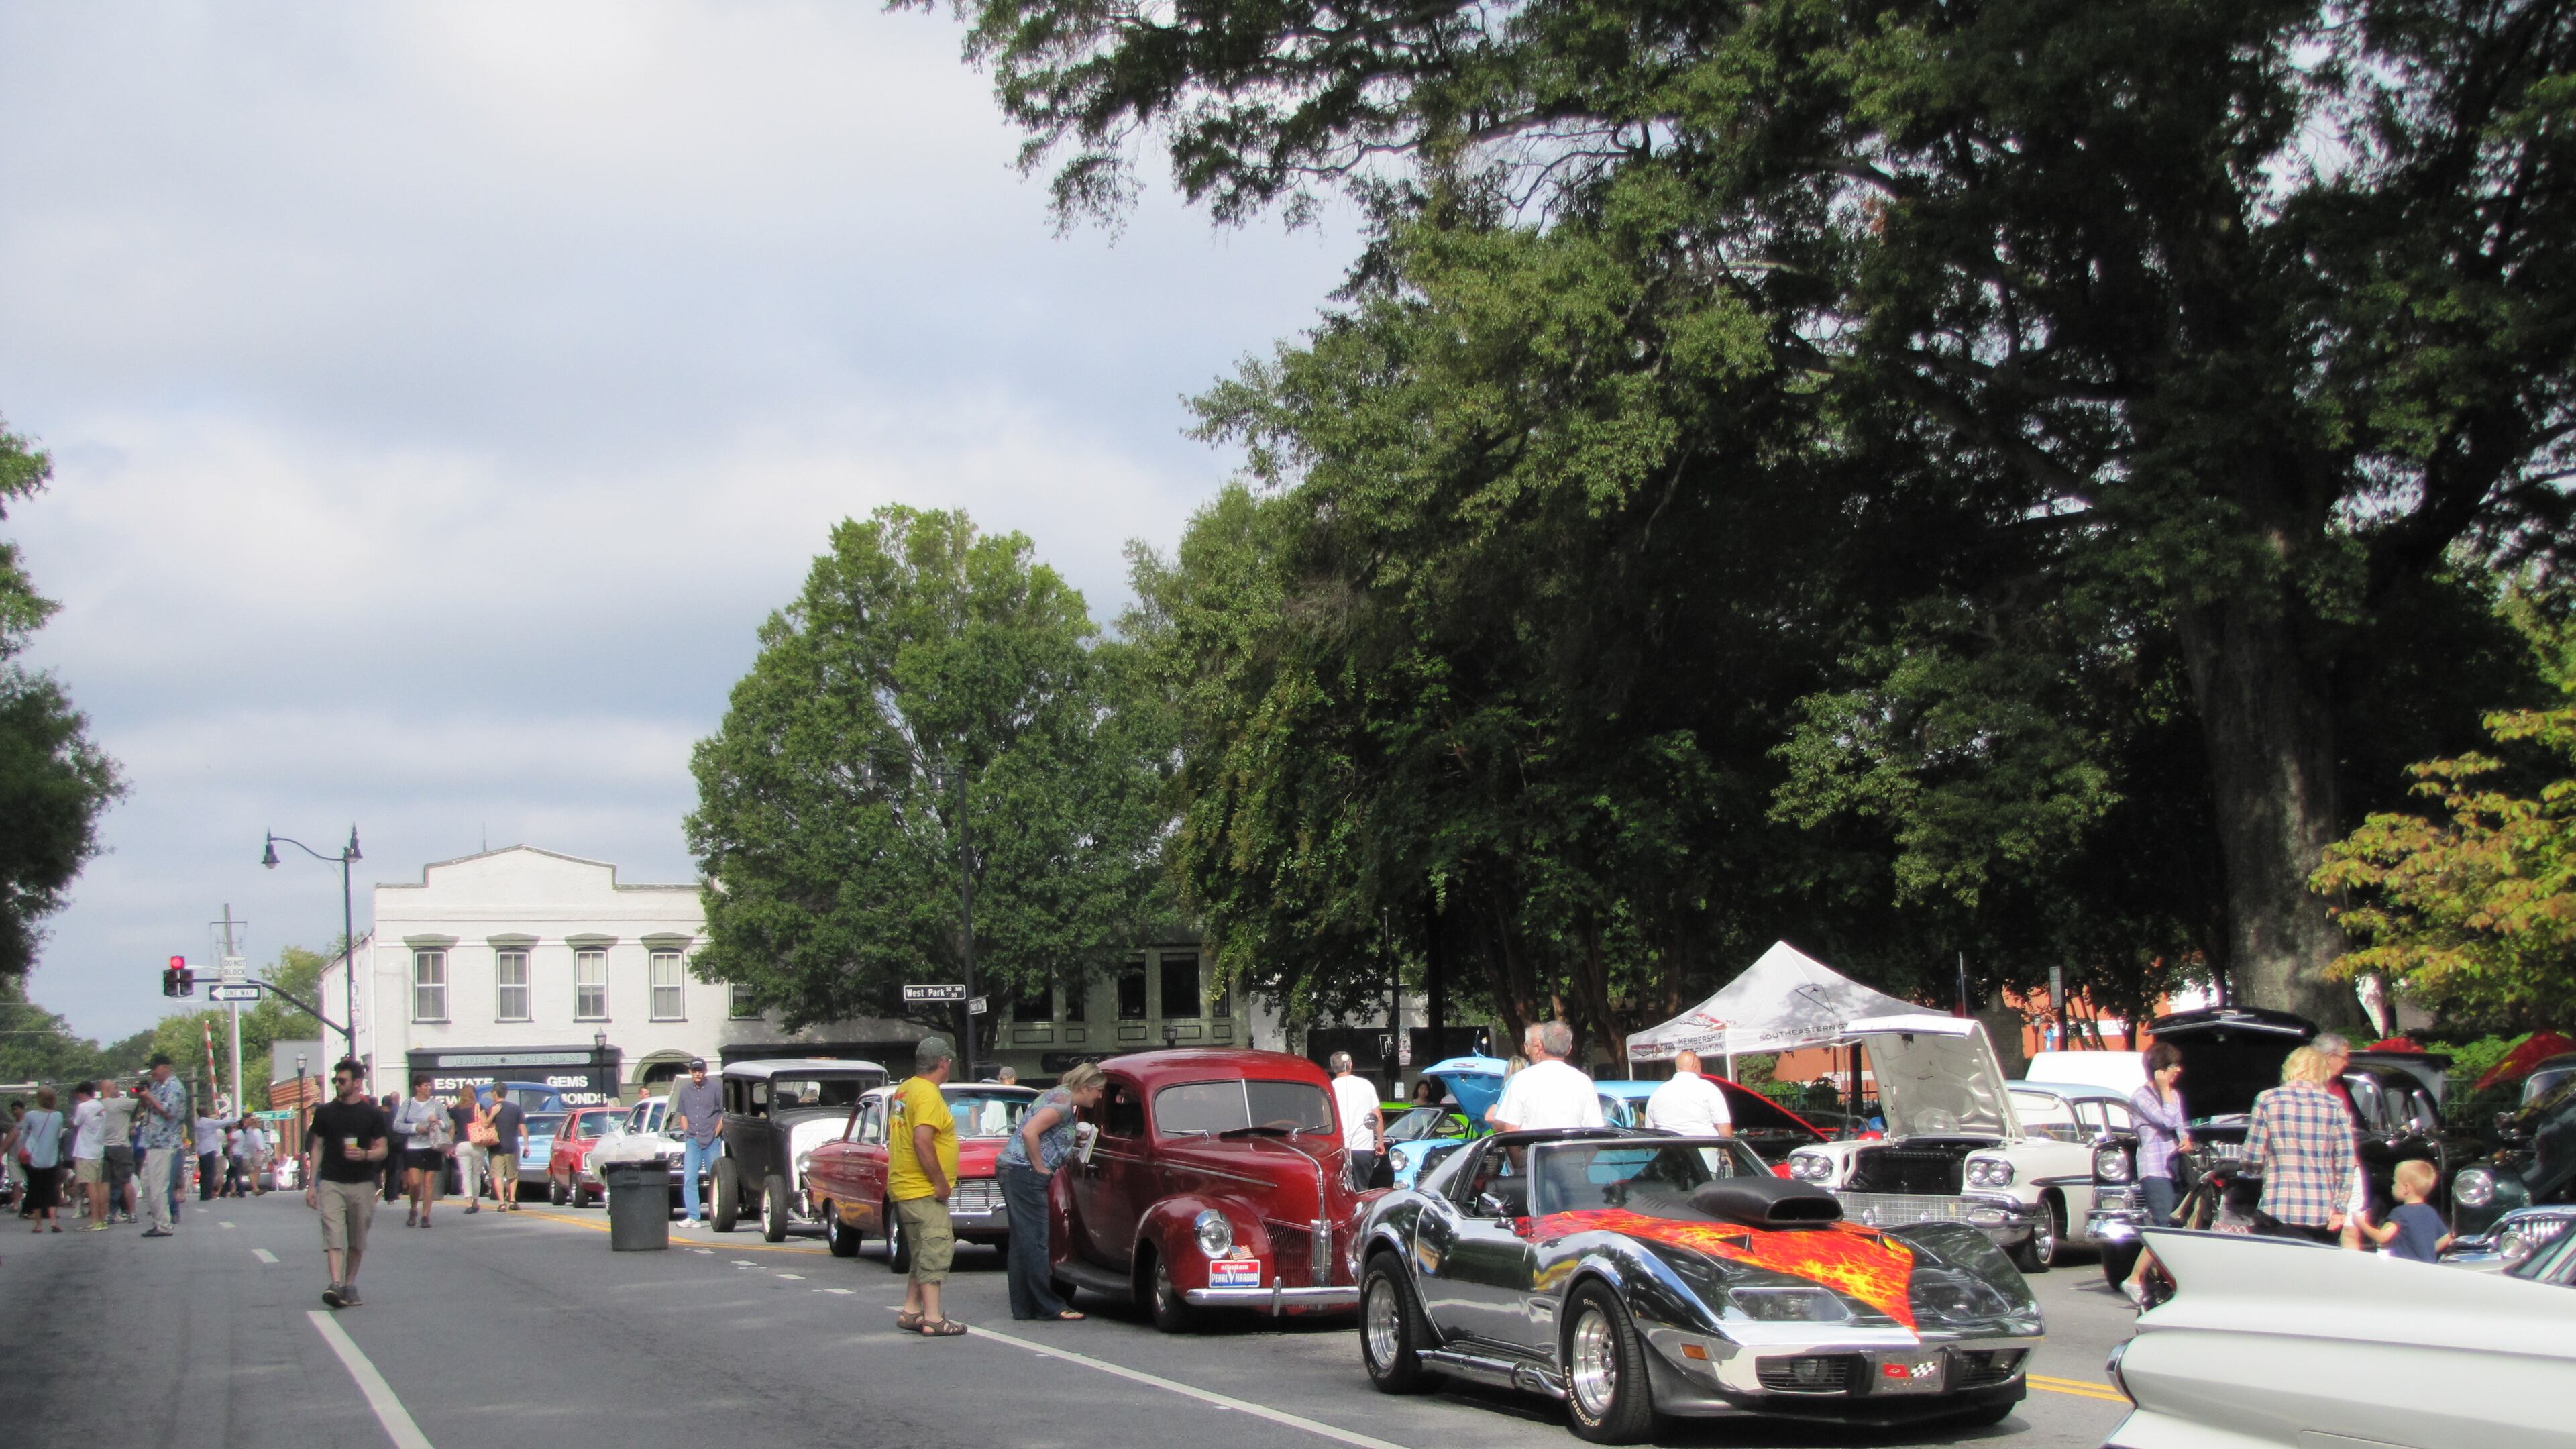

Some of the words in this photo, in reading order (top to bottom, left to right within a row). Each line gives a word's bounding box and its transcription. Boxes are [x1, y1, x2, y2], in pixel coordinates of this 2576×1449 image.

[906, 989, 924, 997] West
[928, 989, 945, 997] Park
[1759, 1023, 1836, 1042] SOUTHEASTERN
[1678, 1032, 1723, 1046] MEMBERSHIP
[547, 1075, 588, 1087] GEMS
[1212, 1273, 1228, 1283] PEARL
[1235, 1272, 1258, 1282] HARBOR
